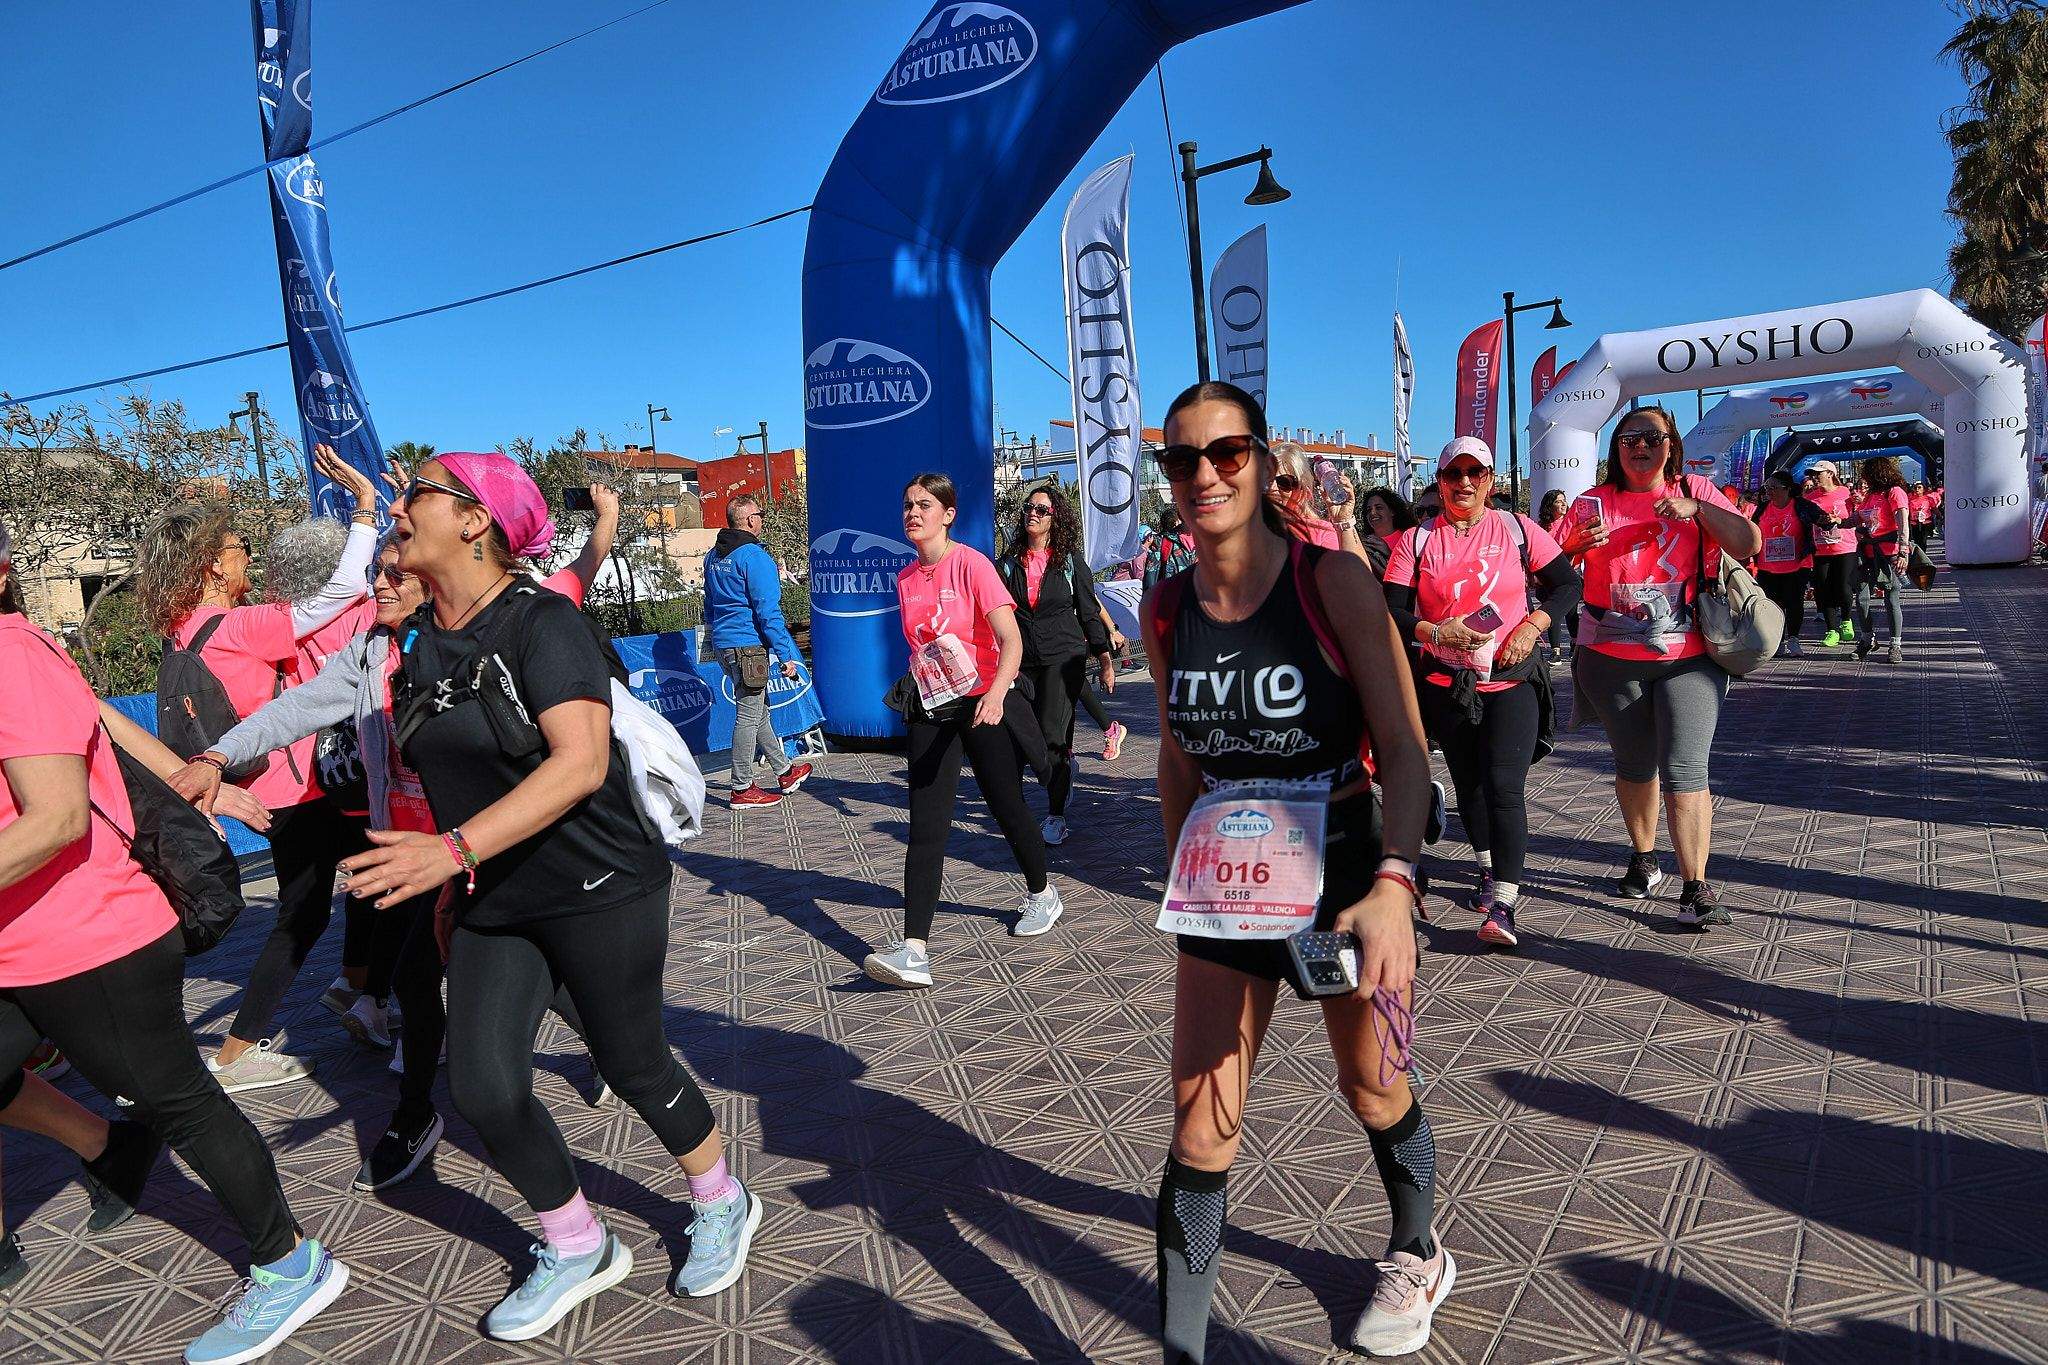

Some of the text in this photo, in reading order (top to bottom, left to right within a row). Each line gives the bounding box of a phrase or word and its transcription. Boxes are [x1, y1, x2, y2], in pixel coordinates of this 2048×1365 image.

[906, 22, 1014, 61] CENTRAL LECHERA
[881, 36, 1024, 95] ASTURIANA
[1657, 317, 1854, 374] OYSHO
[1917, 340, 1985, 359] OYSHO
[810, 367, 911, 382] CENTRAL LECHERA
[1075, 241, 1135, 515] OYSHO
[1554, 388, 1605, 404] OYSHO
[1770, 411, 1810, 420] TotalEnergies
[1955, 416, 2019, 434] OYSHO
[1812, 431, 1899, 446] VOLVO
[1533, 457, 1580, 471] OYSHO
[1956, 494, 2019, 510] OYSHO
[814, 559, 852, 568] CENTRAL
[811, 571, 900, 594] STURIAN
[1168, 669, 1236, 706] ITV
[1220, 821, 1270, 832] ASTURIANA
[1216, 861, 1270, 884] 016
[1224, 890, 1251, 900] 6518
[1182, 903, 1212, 913] CARRERA
[1212, 904, 1221, 912] DE
[1222, 904, 1231, 912] LA
[1232, 903, 1257, 913] MUJER
[1262, 904, 1296, 915] VALENCIA
[1176, 917, 1296, 931] OYSHO Santander
